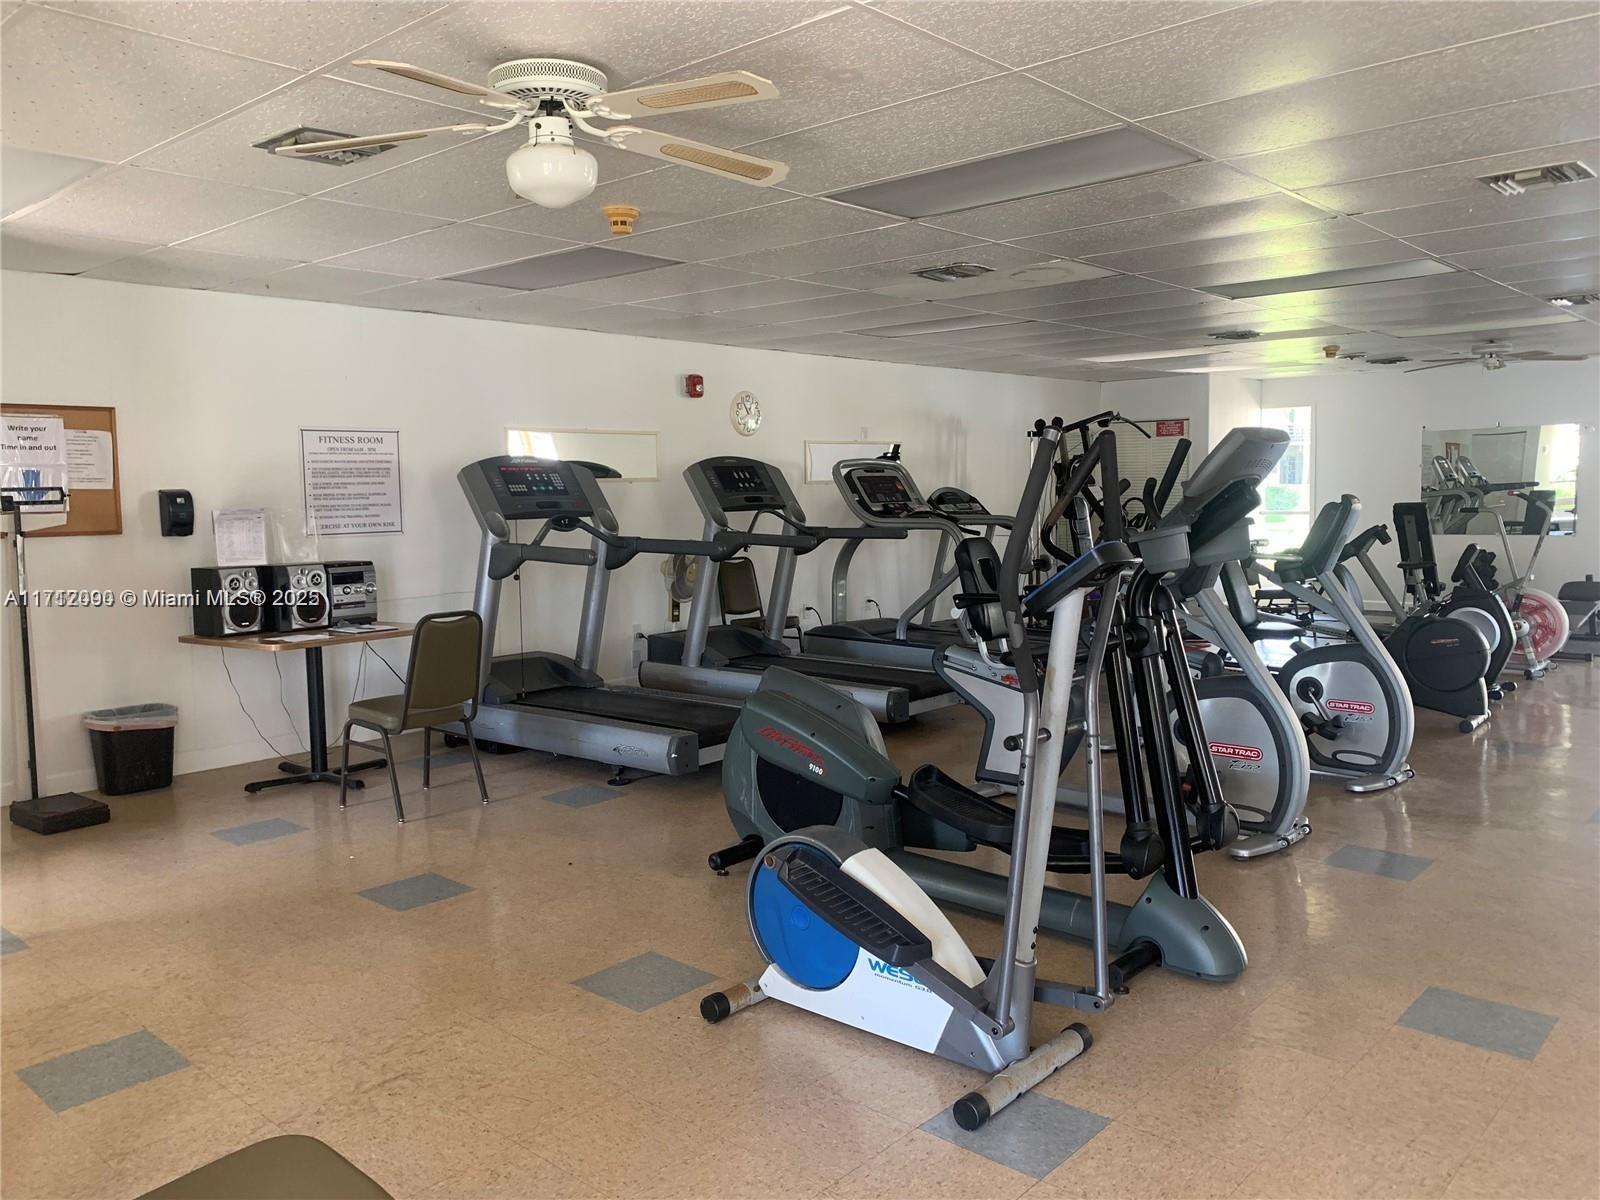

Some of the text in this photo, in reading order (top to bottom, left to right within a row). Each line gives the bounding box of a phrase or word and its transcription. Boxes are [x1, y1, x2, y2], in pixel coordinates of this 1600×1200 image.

[318, 436, 384, 444] FITNESS ROOM
[1328, 701, 1349, 709] STAR
[1211, 745, 1259, 757] STAR TRAC
[808, 763, 823, 775] 9100
[868, 958, 922, 984] WES
